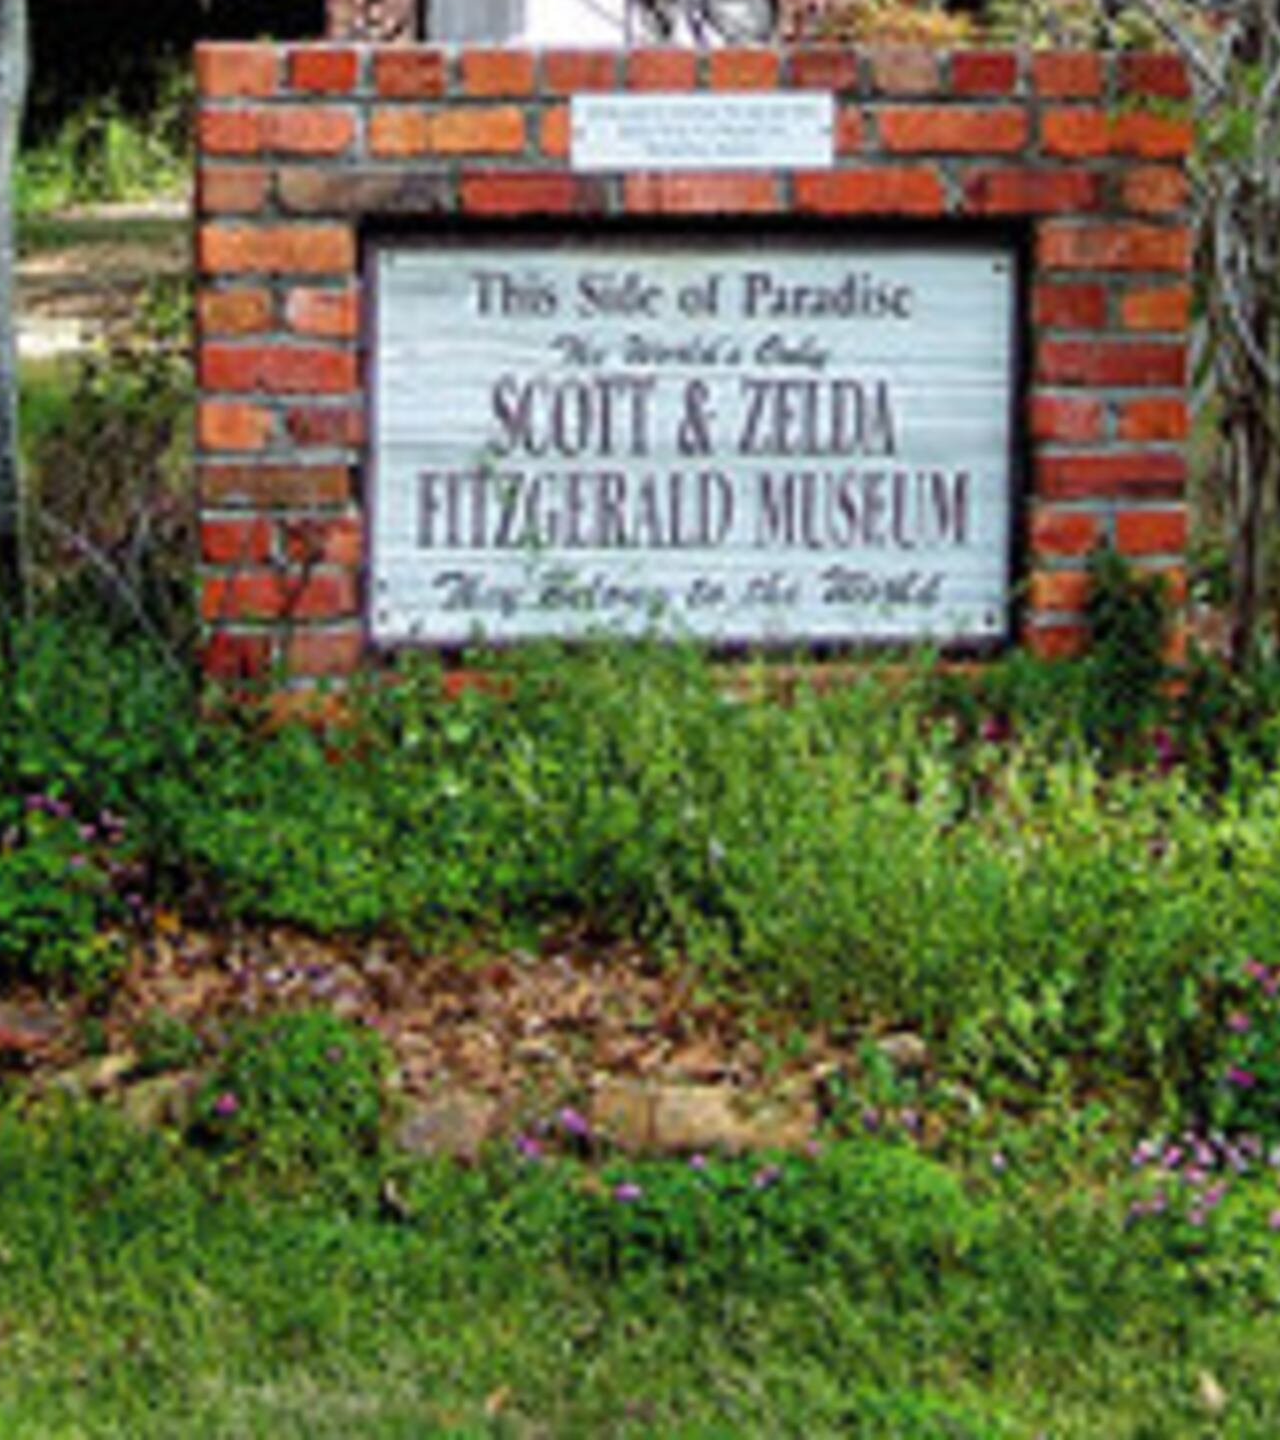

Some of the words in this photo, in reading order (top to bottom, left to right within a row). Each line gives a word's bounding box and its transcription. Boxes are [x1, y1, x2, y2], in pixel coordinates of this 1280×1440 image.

[470, 271, 560, 319] This
[577, 271, 666, 319] Side
[678, 270, 723, 317] of
[742, 271, 914, 319] Paradise
[490, 375, 657, 458] SCOTT
[677, 376, 718, 458] &
[738, 377, 898, 458] ZELDA
[416, 471, 735, 551] FITZGERALD
[752, 471, 972, 551] MUSEUM
[432, 569, 521, 618] They
[537, 569, 672, 618] Belong
[684, 576, 722, 611] to
[731, 570, 805, 611] the
[820, 564, 946, 610] World
